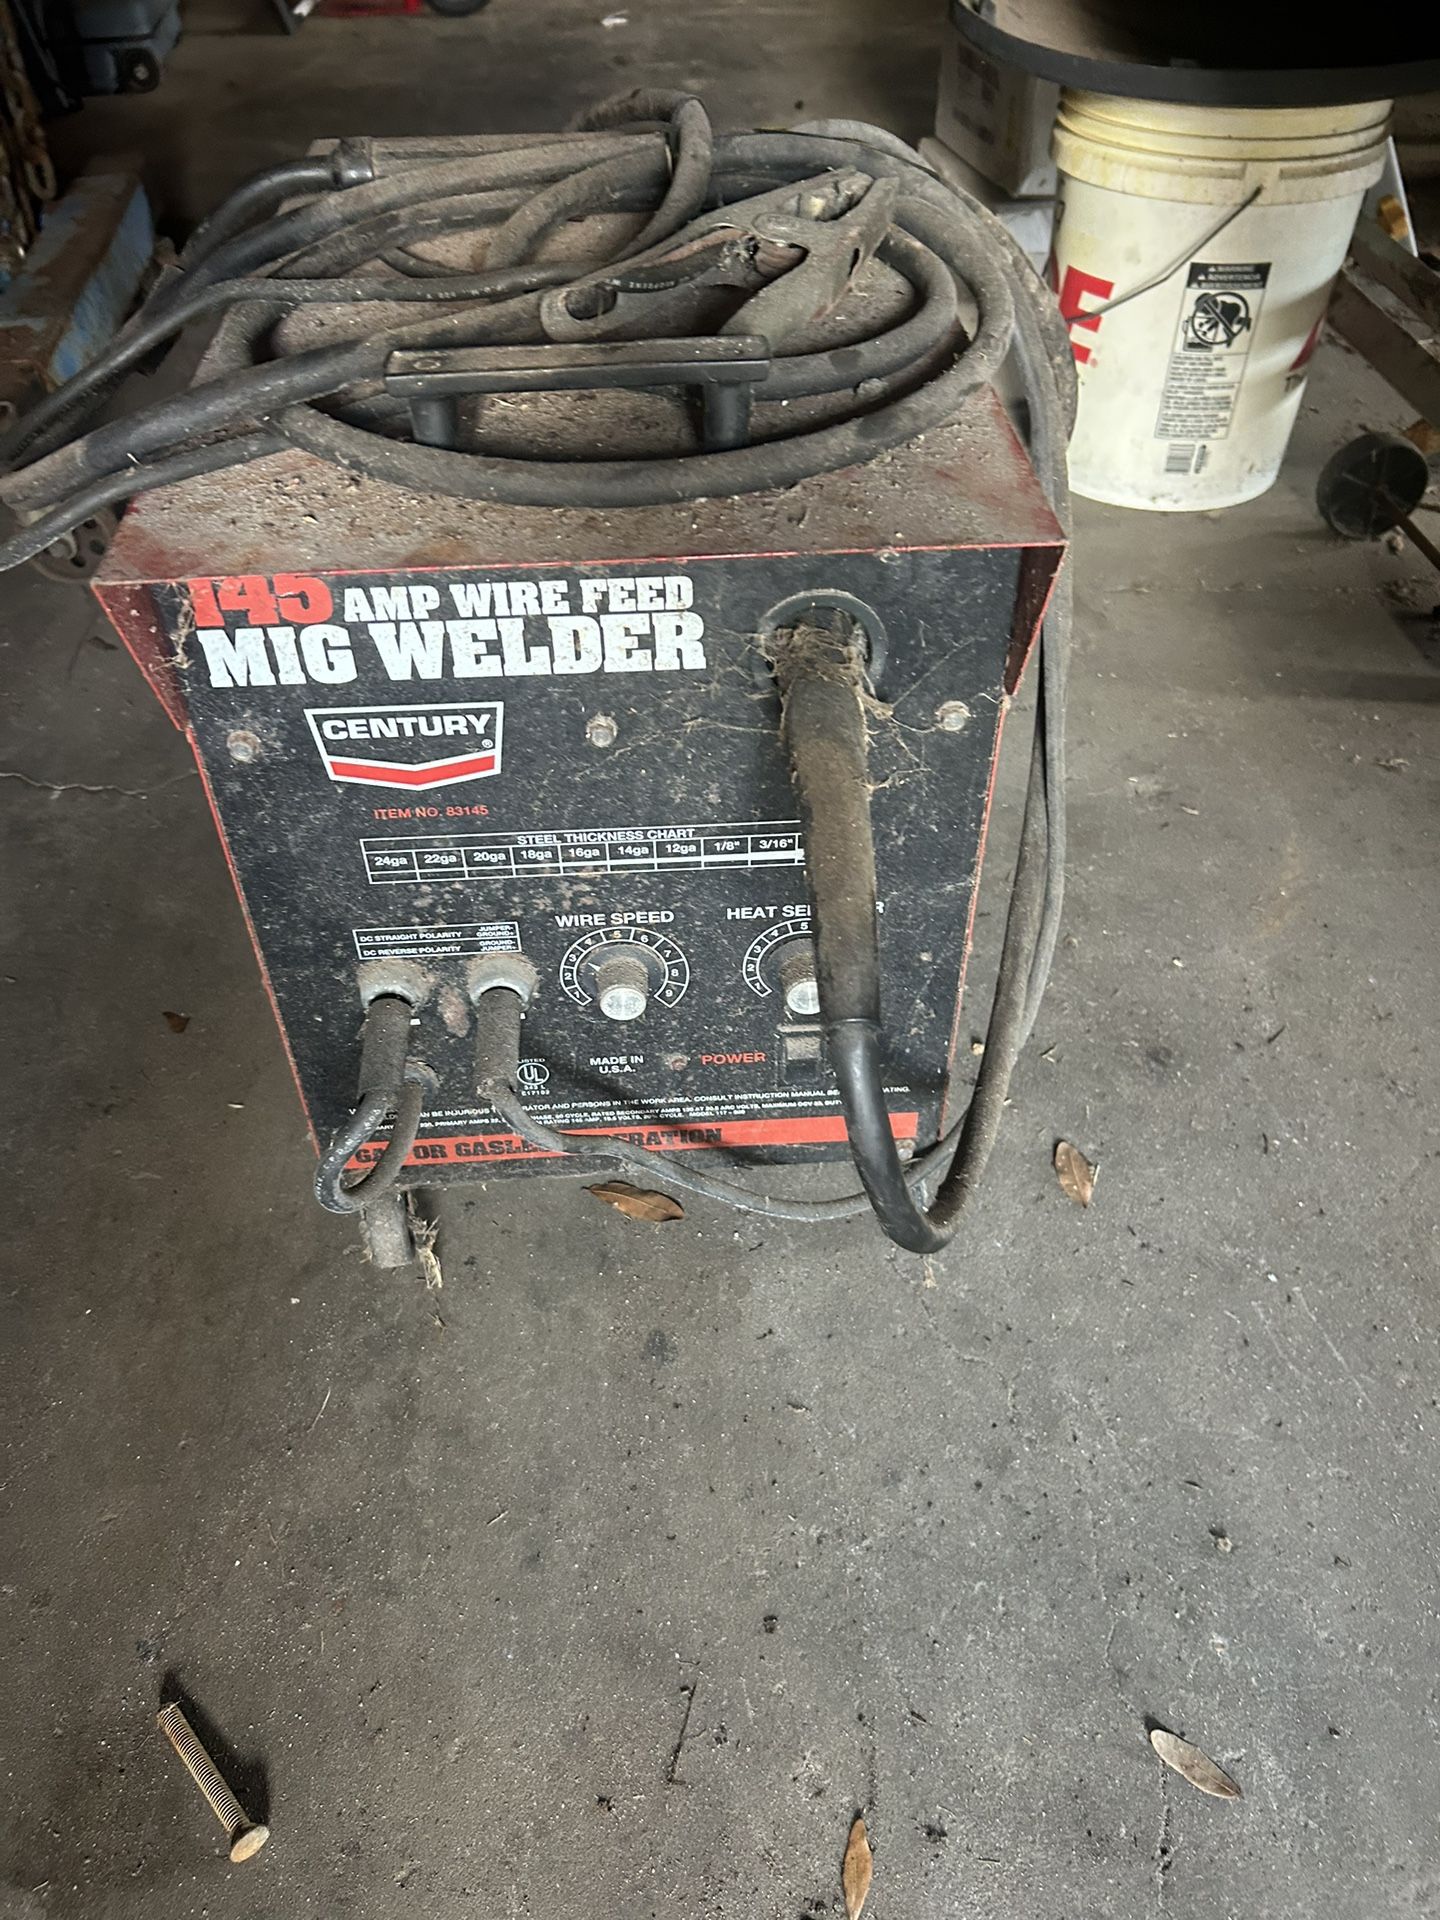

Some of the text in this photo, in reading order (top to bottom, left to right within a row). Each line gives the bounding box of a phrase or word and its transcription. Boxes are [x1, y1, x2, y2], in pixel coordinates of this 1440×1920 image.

[187, 573, 694, 627] 145 AMP WIRE FEED
[196, 611, 707, 688] MIG WELDER
[322, 714, 491, 740] CENTURY
[373, 805, 489, 820] ITEM NO. 83145
[517, 828, 695, 845] STEEL THICKNESS CHART
[374, 838, 794, 868] 24ga 22ga 20ga 18ga 16ga 14ga 12ga 1/8" 3/16"
[555, 911, 675, 928] WIRE SPEED
[726, 906, 778, 920] HEAT
[374, 933, 417, 941] STRAIGHT
[420, 931, 462, 939] POLARITY
[363, 945, 462, 957] DC REVERSE POLARITY
[747, 964, 755, 972] 2
[753, 945, 762, 953] 3
[770, 929, 779, 937] 4
[800, 921, 809, 930] 5
[564, 930, 680, 999] 1 2 3 4 5 6 7 8 9
[590, 1055, 644, 1066] MADE IN
[701, 1052, 766, 1065] POWER
[599, 1065, 636, 1074] U.S.A.
[522, 1103, 551, 1111] RATOR
[734, 1092, 789, 1100] INSTRUCTION
[445, 1108, 490, 1116] INJURIOUS
[413, 1144, 448, 1159] OR
